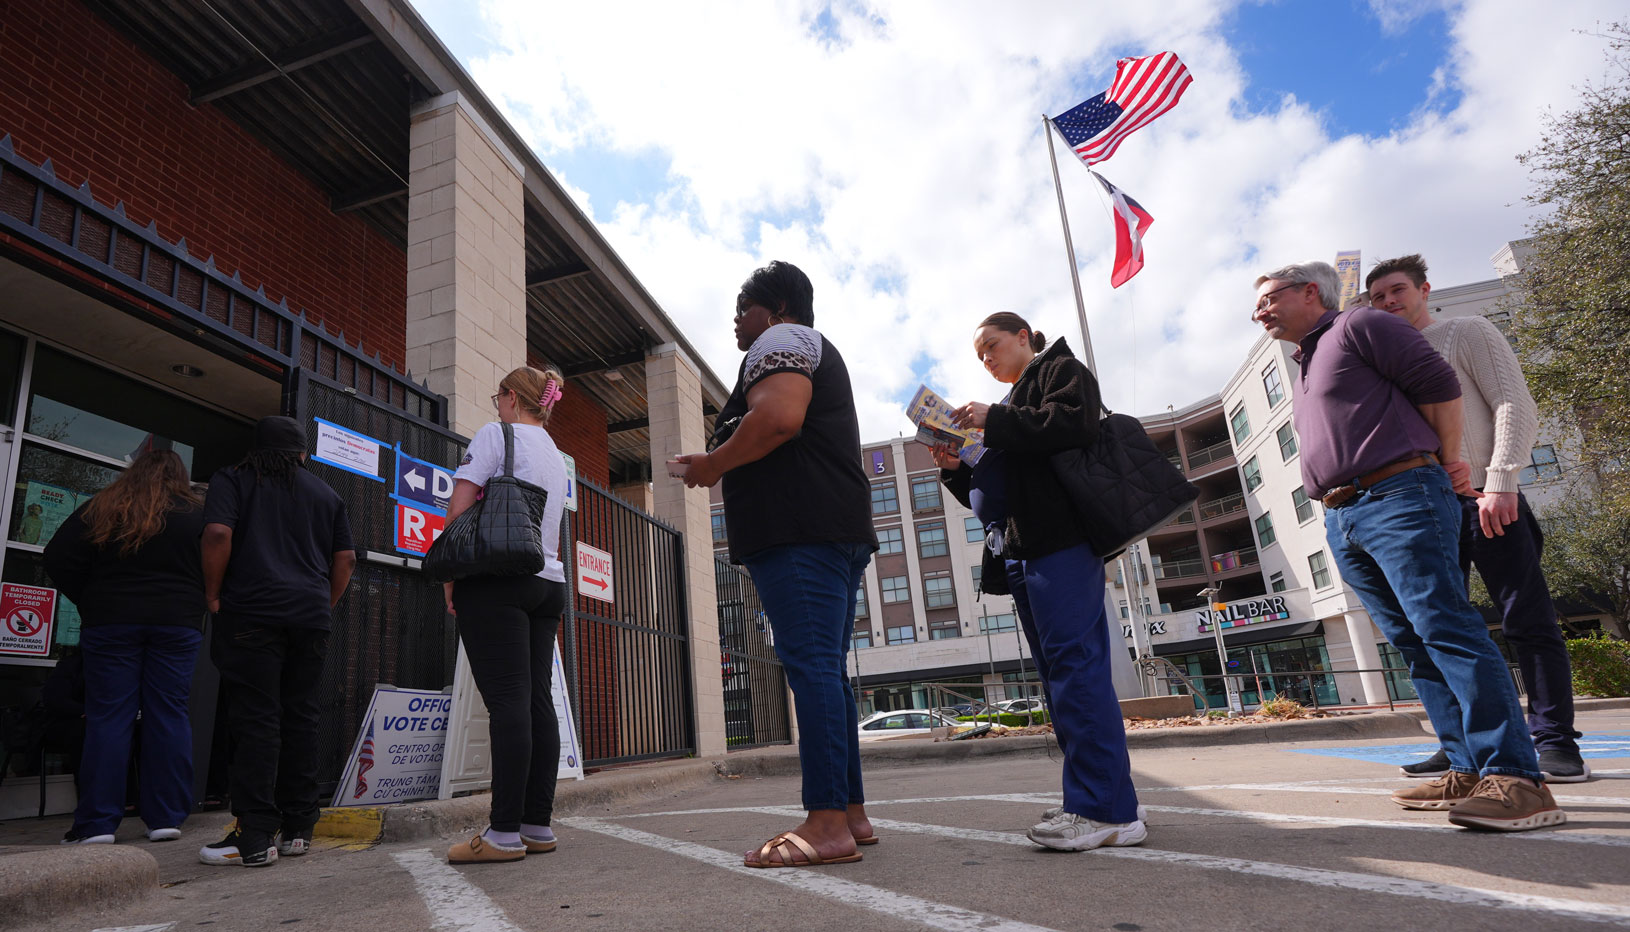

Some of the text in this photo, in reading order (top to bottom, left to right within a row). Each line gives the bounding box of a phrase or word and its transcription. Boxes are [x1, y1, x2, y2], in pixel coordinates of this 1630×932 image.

[876, 462, 885, 474] 3
[432, 468, 454, 499] D
[40, 495, 64, 504] CHECK
[41, 489, 65, 499] READY
[403, 506, 426, 542] R
[579, 551, 611, 577] ENTRANCE
[10, 586, 48, 596] BATHROOM
[5, 592, 51, 602] TEMPORARILY
[14, 599, 41, 607] CLOSED
[1196, 596, 1287, 626] NAIL BAR
[18, 637, 43, 645] CERRADO
[408, 697, 451, 713] OFFIC
[383, 716, 429, 731] VOTE
[388, 743, 430, 754] CENTRO
[391, 755, 408, 765] DE
[377, 777, 413, 788] TRUNG
